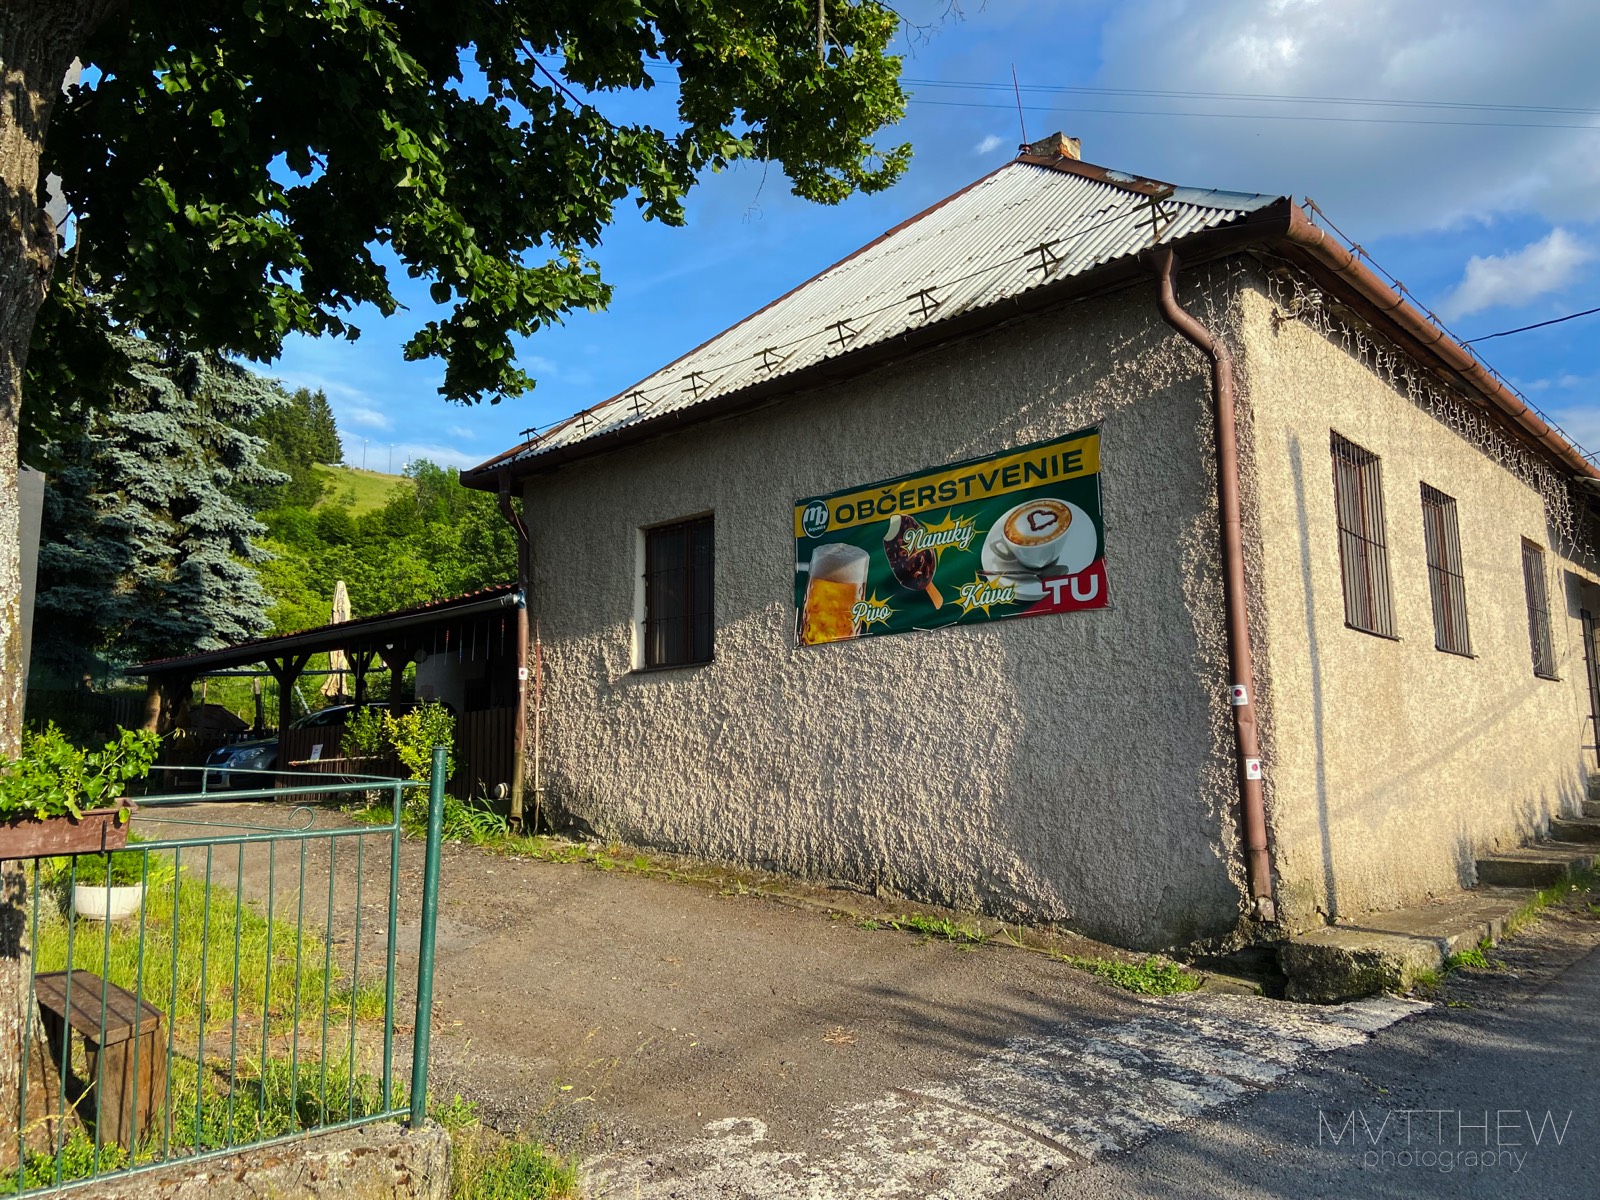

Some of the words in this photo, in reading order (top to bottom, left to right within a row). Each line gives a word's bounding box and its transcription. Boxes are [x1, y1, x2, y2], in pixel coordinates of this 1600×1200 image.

[835, 450, 1083, 524] OBČERSTVENIE
[905, 517, 974, 551] Nanuky
[962, 582, 1015, 609] Káva
[1046, 573, 1099, 605] TU
[852, 602, 890, 624] Pivo
